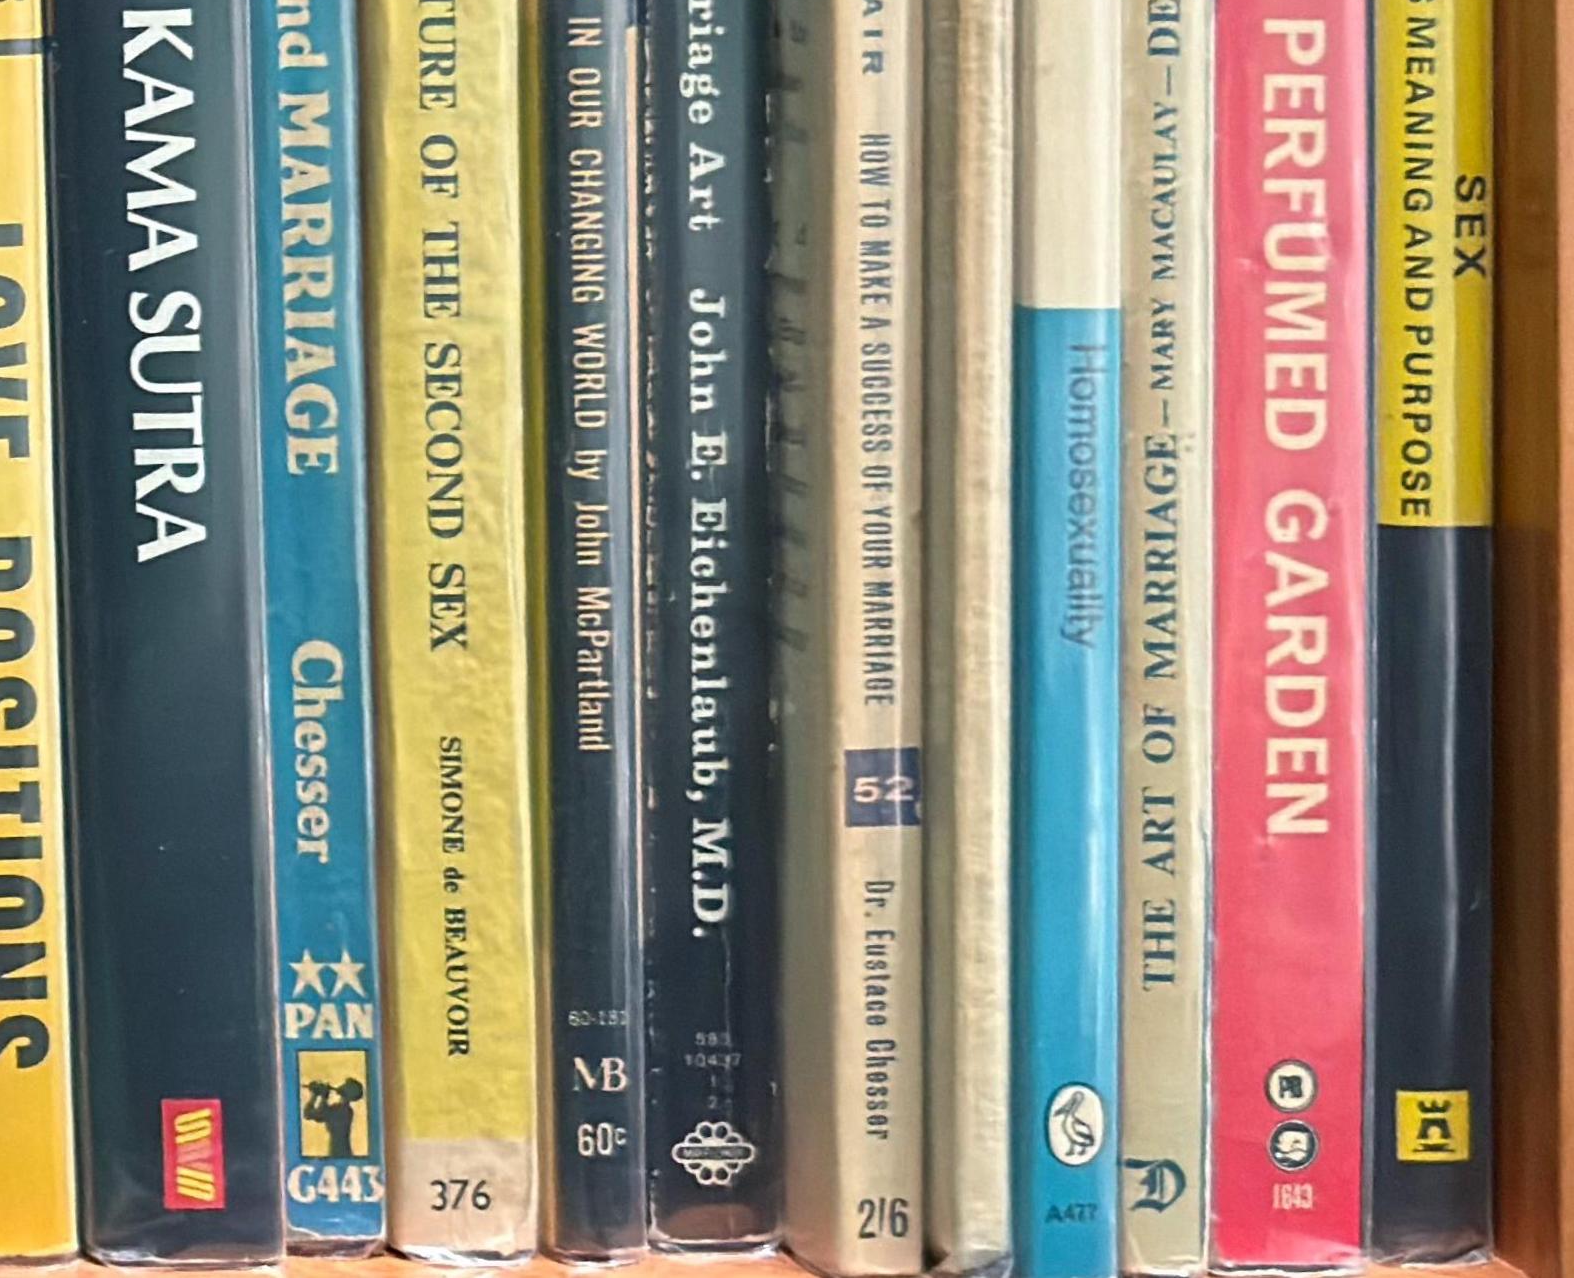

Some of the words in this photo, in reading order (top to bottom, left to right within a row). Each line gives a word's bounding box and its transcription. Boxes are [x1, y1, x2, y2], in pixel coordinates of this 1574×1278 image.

[122, 9, 198, 274] KAMA
[1404, 18, 1436, 205] MEANING
[420, 132, 460, 198] OF
[688, 138, 723, 231] Art
[422, 220, 460, 321] THE
[1263, 20, 1326, 450] PERFUMED
[1404, 222, 1434, 312] AND
[1453, 174, 1485, 280] SEX
[279, 90, 338, 476] MARRIAGE
[128, 290, 206, 563] SUTRA
[424, 341, 463, 540] SECOND
[1404, 325, 1431, 518] PURPOSE
[429, 561, 468, 652] SEX
[1265, 488, 1328, 835] GARDEN
[290, 638, 343, 864] Chesser
[1142, 703, 1178, 766] OF
[439, 736, 463, 854] SIMONE
[852, 777, 914, 802] 52
[1142, 787, 1178, 878] ART
[442, 866, 460, 894] de
[444, 909, 471, 1058] BEAUVOIR
[1143, 900, 1176, 991] THE
[285, 1003, 374, 1039] PAN
[287, 1165, 386, 1203] G443
[430, 1178, 490, 1211] 376
